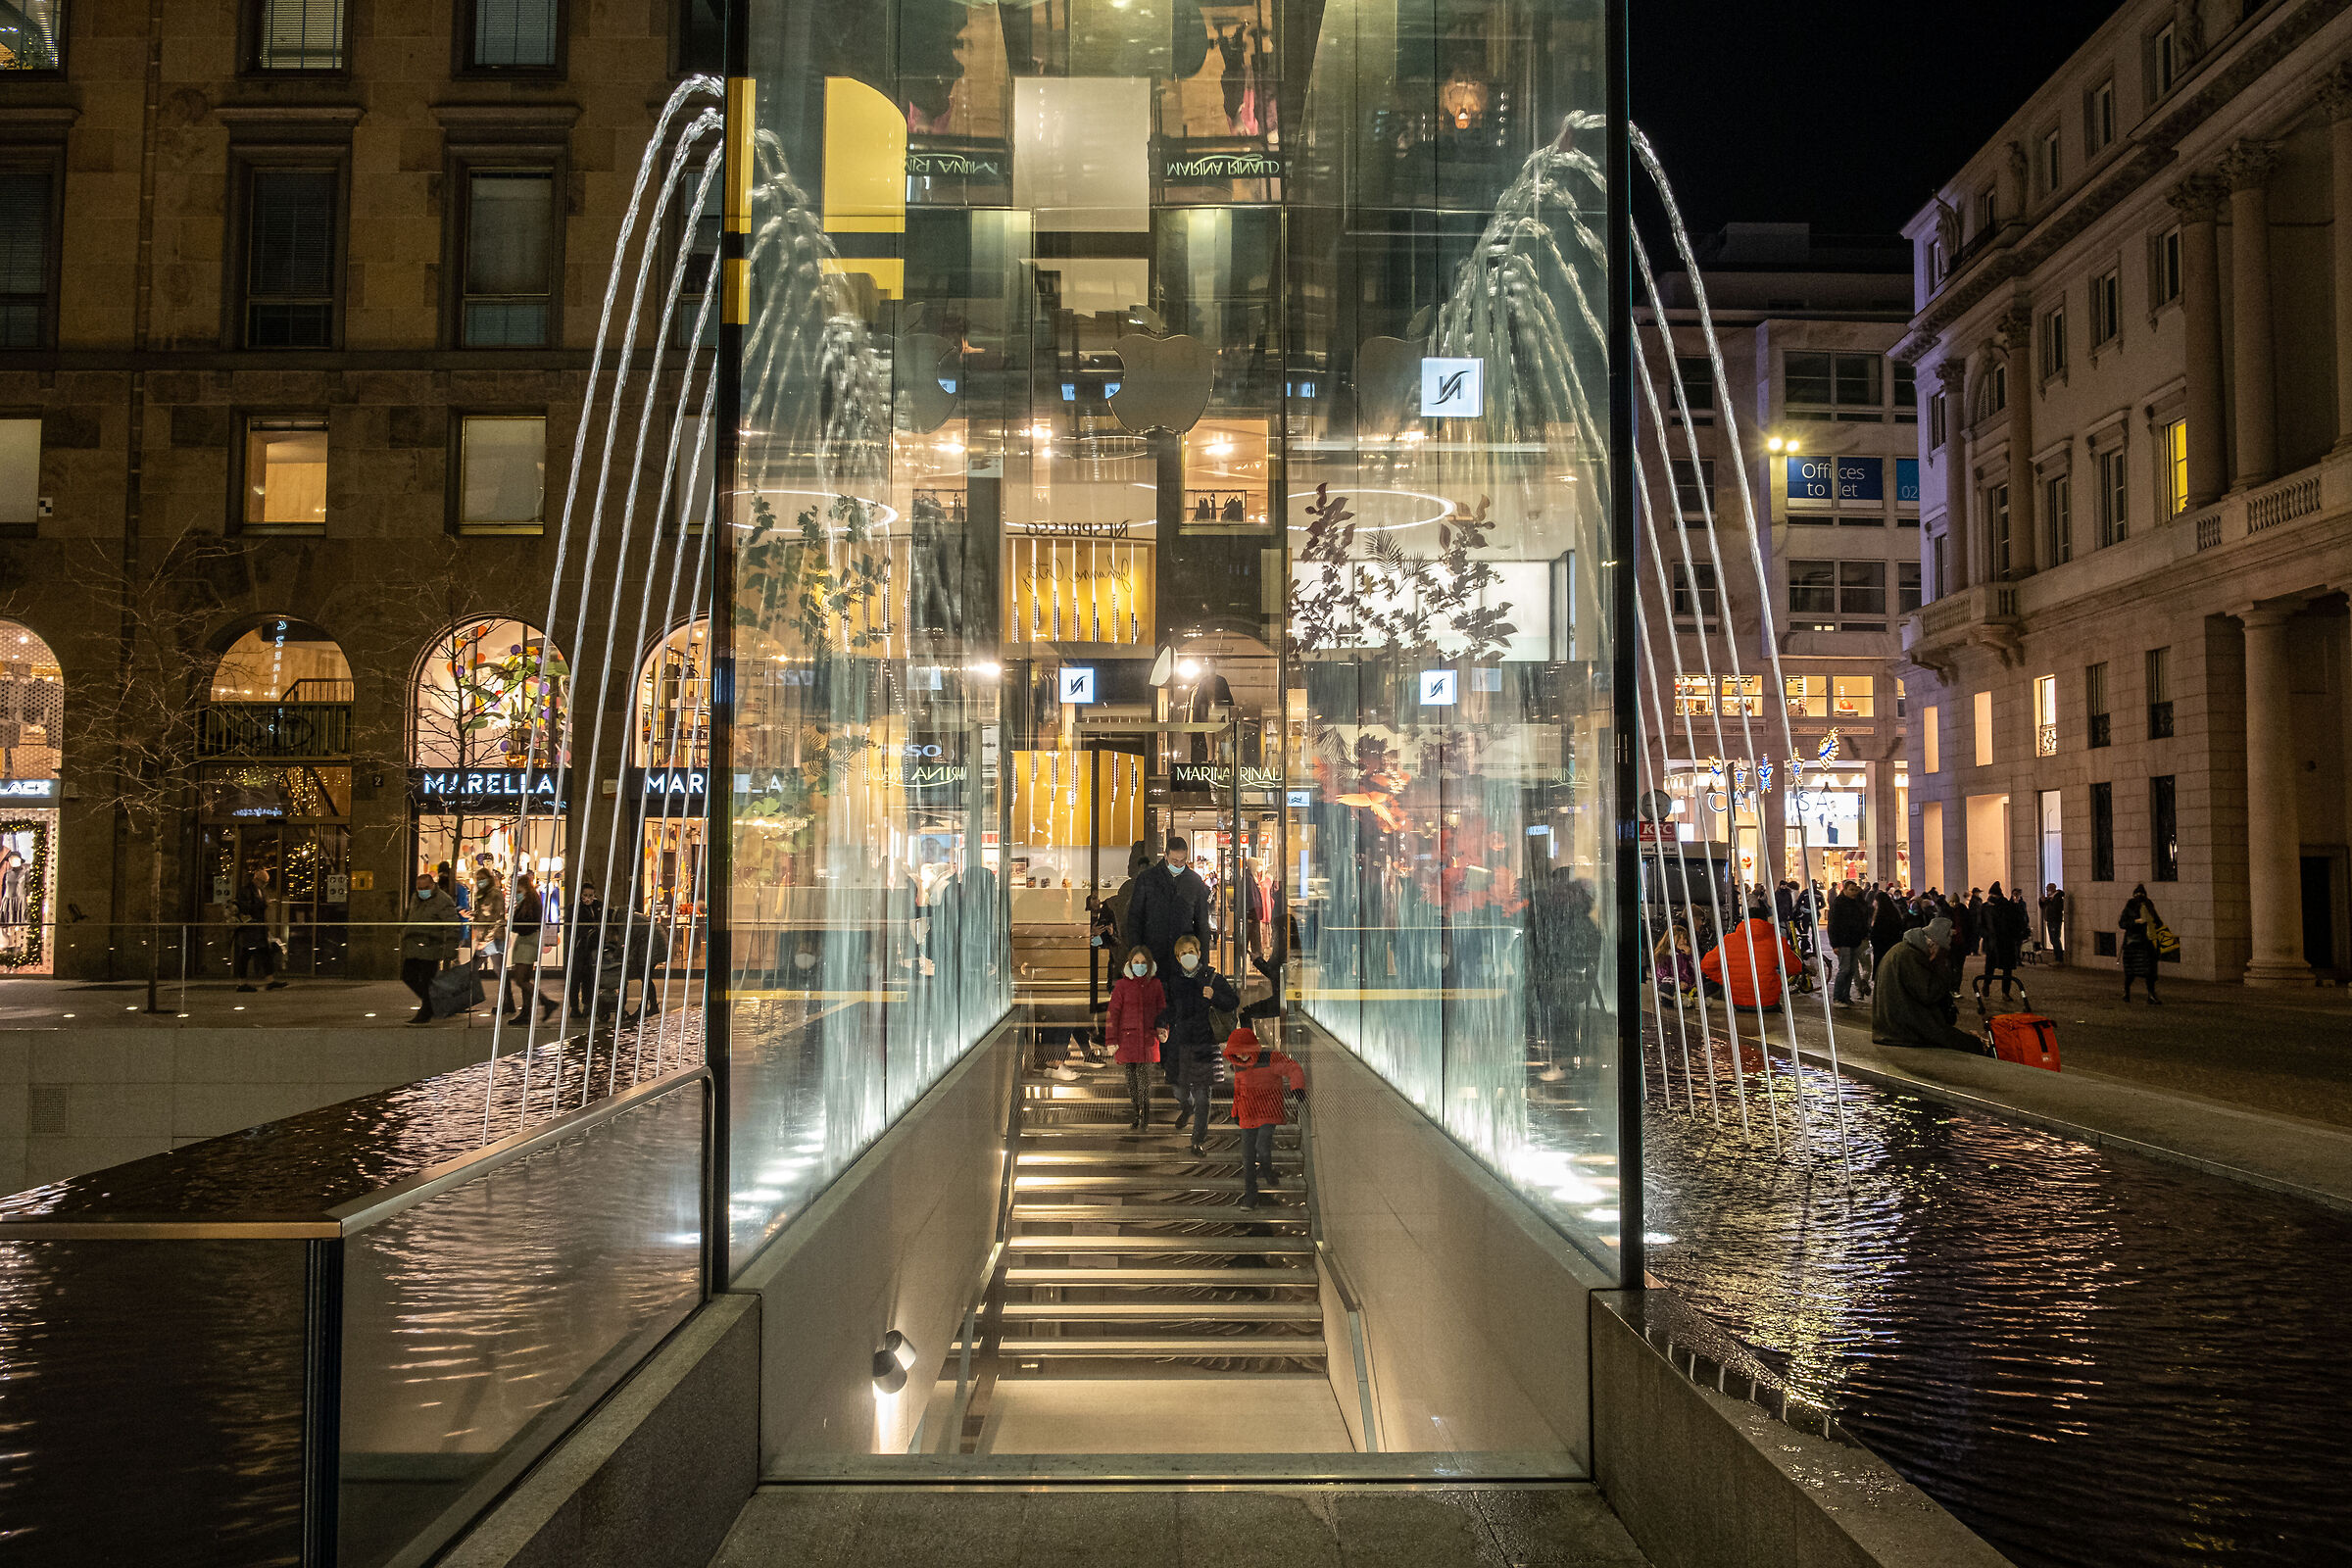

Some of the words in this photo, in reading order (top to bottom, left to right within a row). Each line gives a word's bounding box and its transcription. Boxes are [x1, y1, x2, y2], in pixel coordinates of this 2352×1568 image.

[1801, 463, 1865, 480] Offices
[1807, 482, 1826, 496] to
[1838, 481, 1858, 497] let
[423, 773, 556, 794] MARELLA
[1176, 766, 1230, 787] MARINA
[1642, 823, 1672, 834] KC
